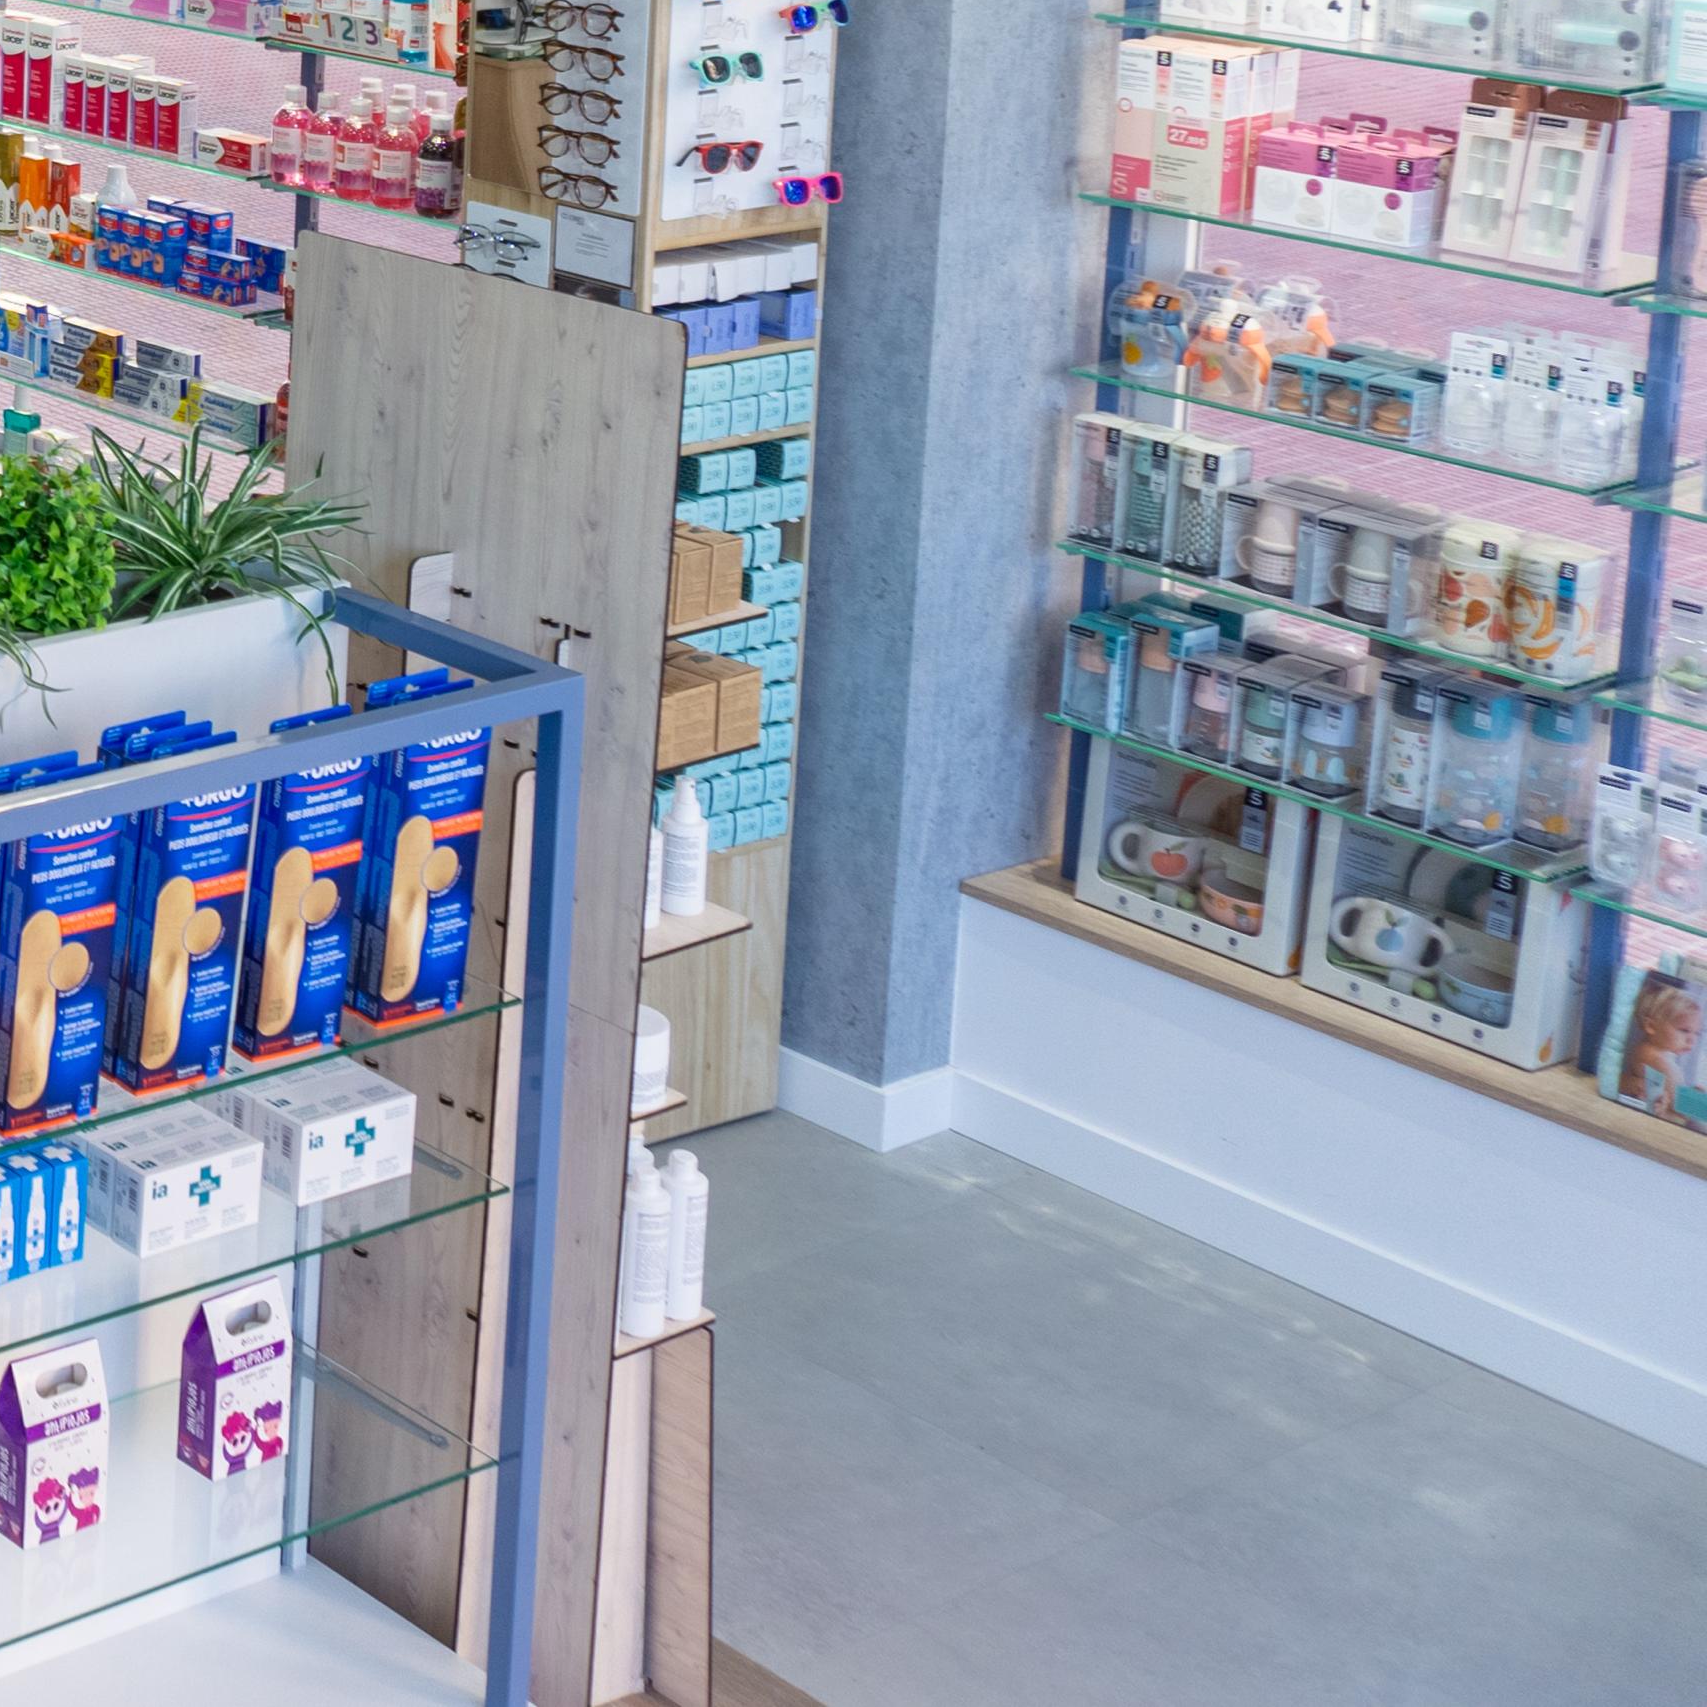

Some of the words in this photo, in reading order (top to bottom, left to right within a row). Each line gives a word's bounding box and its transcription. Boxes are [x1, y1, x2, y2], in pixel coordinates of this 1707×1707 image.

[188, 5, 208, 14] Lacer
[322, 13, 333, 38] 1
[341, 17, 355, 42] 2
[365, 21, 378, 45] 3
[2, 34, 24, 44] Lacer
[30, 38, 52, 48] Lacer
[86, 72, 105, 80] Lacer
[109, 77, 128, 86] Lacer
[134, 85, 154, 93] Lacer
[158, 90, 178, 98] Lacer
[198, 146, 217, 155] Lacer
[28, 235, 48, 245] Lacer
[308, 1131, 324, 1150] ia
[152, 1180, 168, 1200] ia
